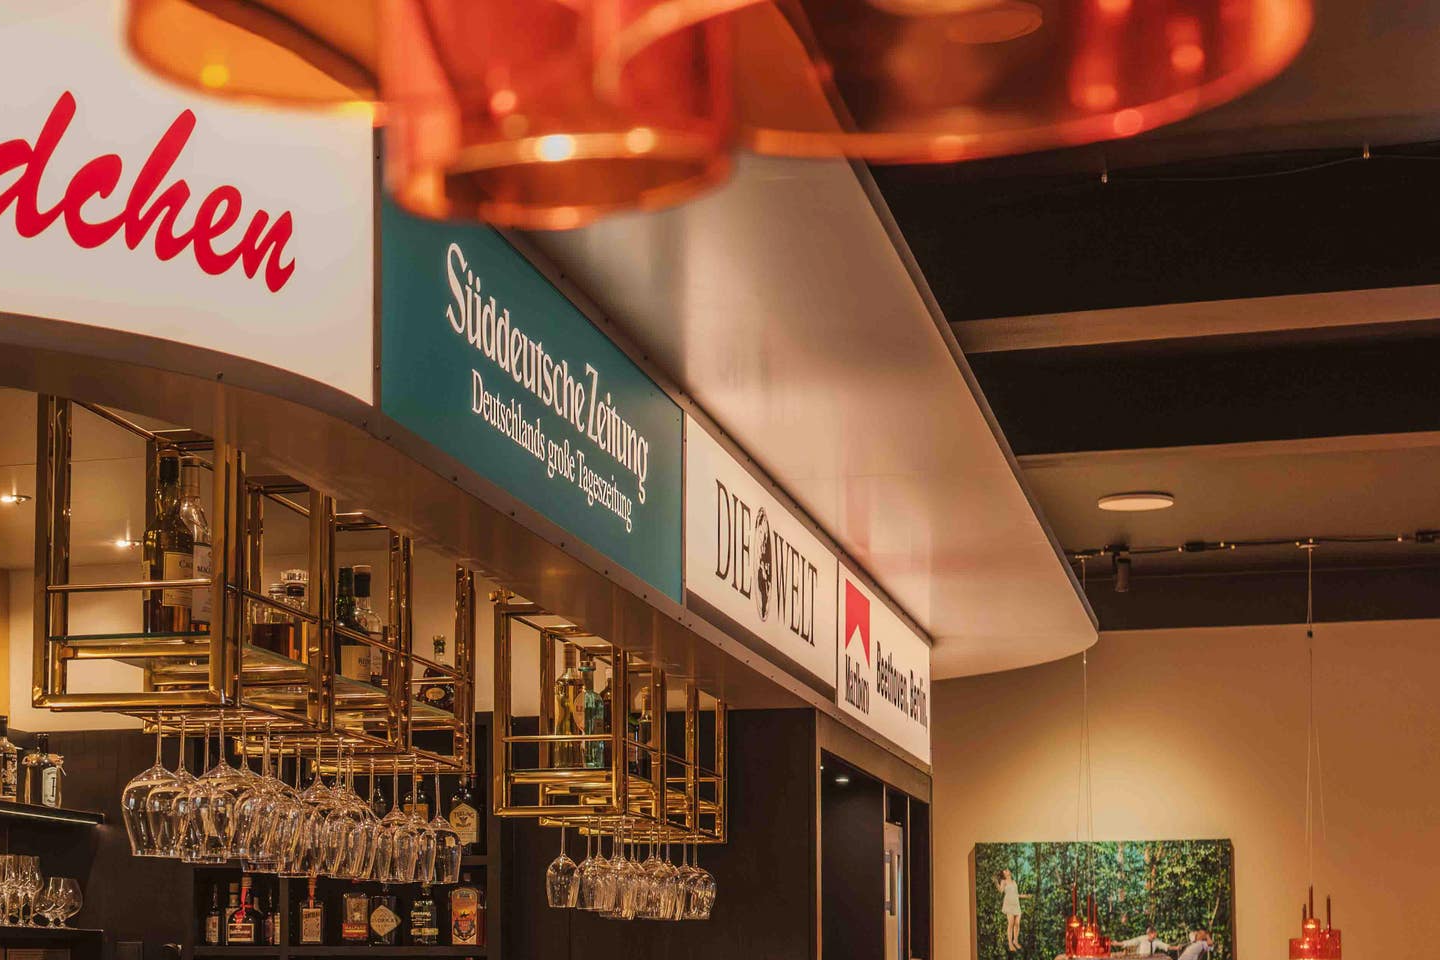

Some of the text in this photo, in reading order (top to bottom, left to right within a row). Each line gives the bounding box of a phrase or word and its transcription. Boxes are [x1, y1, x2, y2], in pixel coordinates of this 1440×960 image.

[445, 242, 649, 505] Süddeutsche Zeitung
[471, 368, 633, 534] Deutschlands große Tageszeitung
[715, 478, 819, 648] DIE WELT
[844, 653, 870, 716] Marlboro
